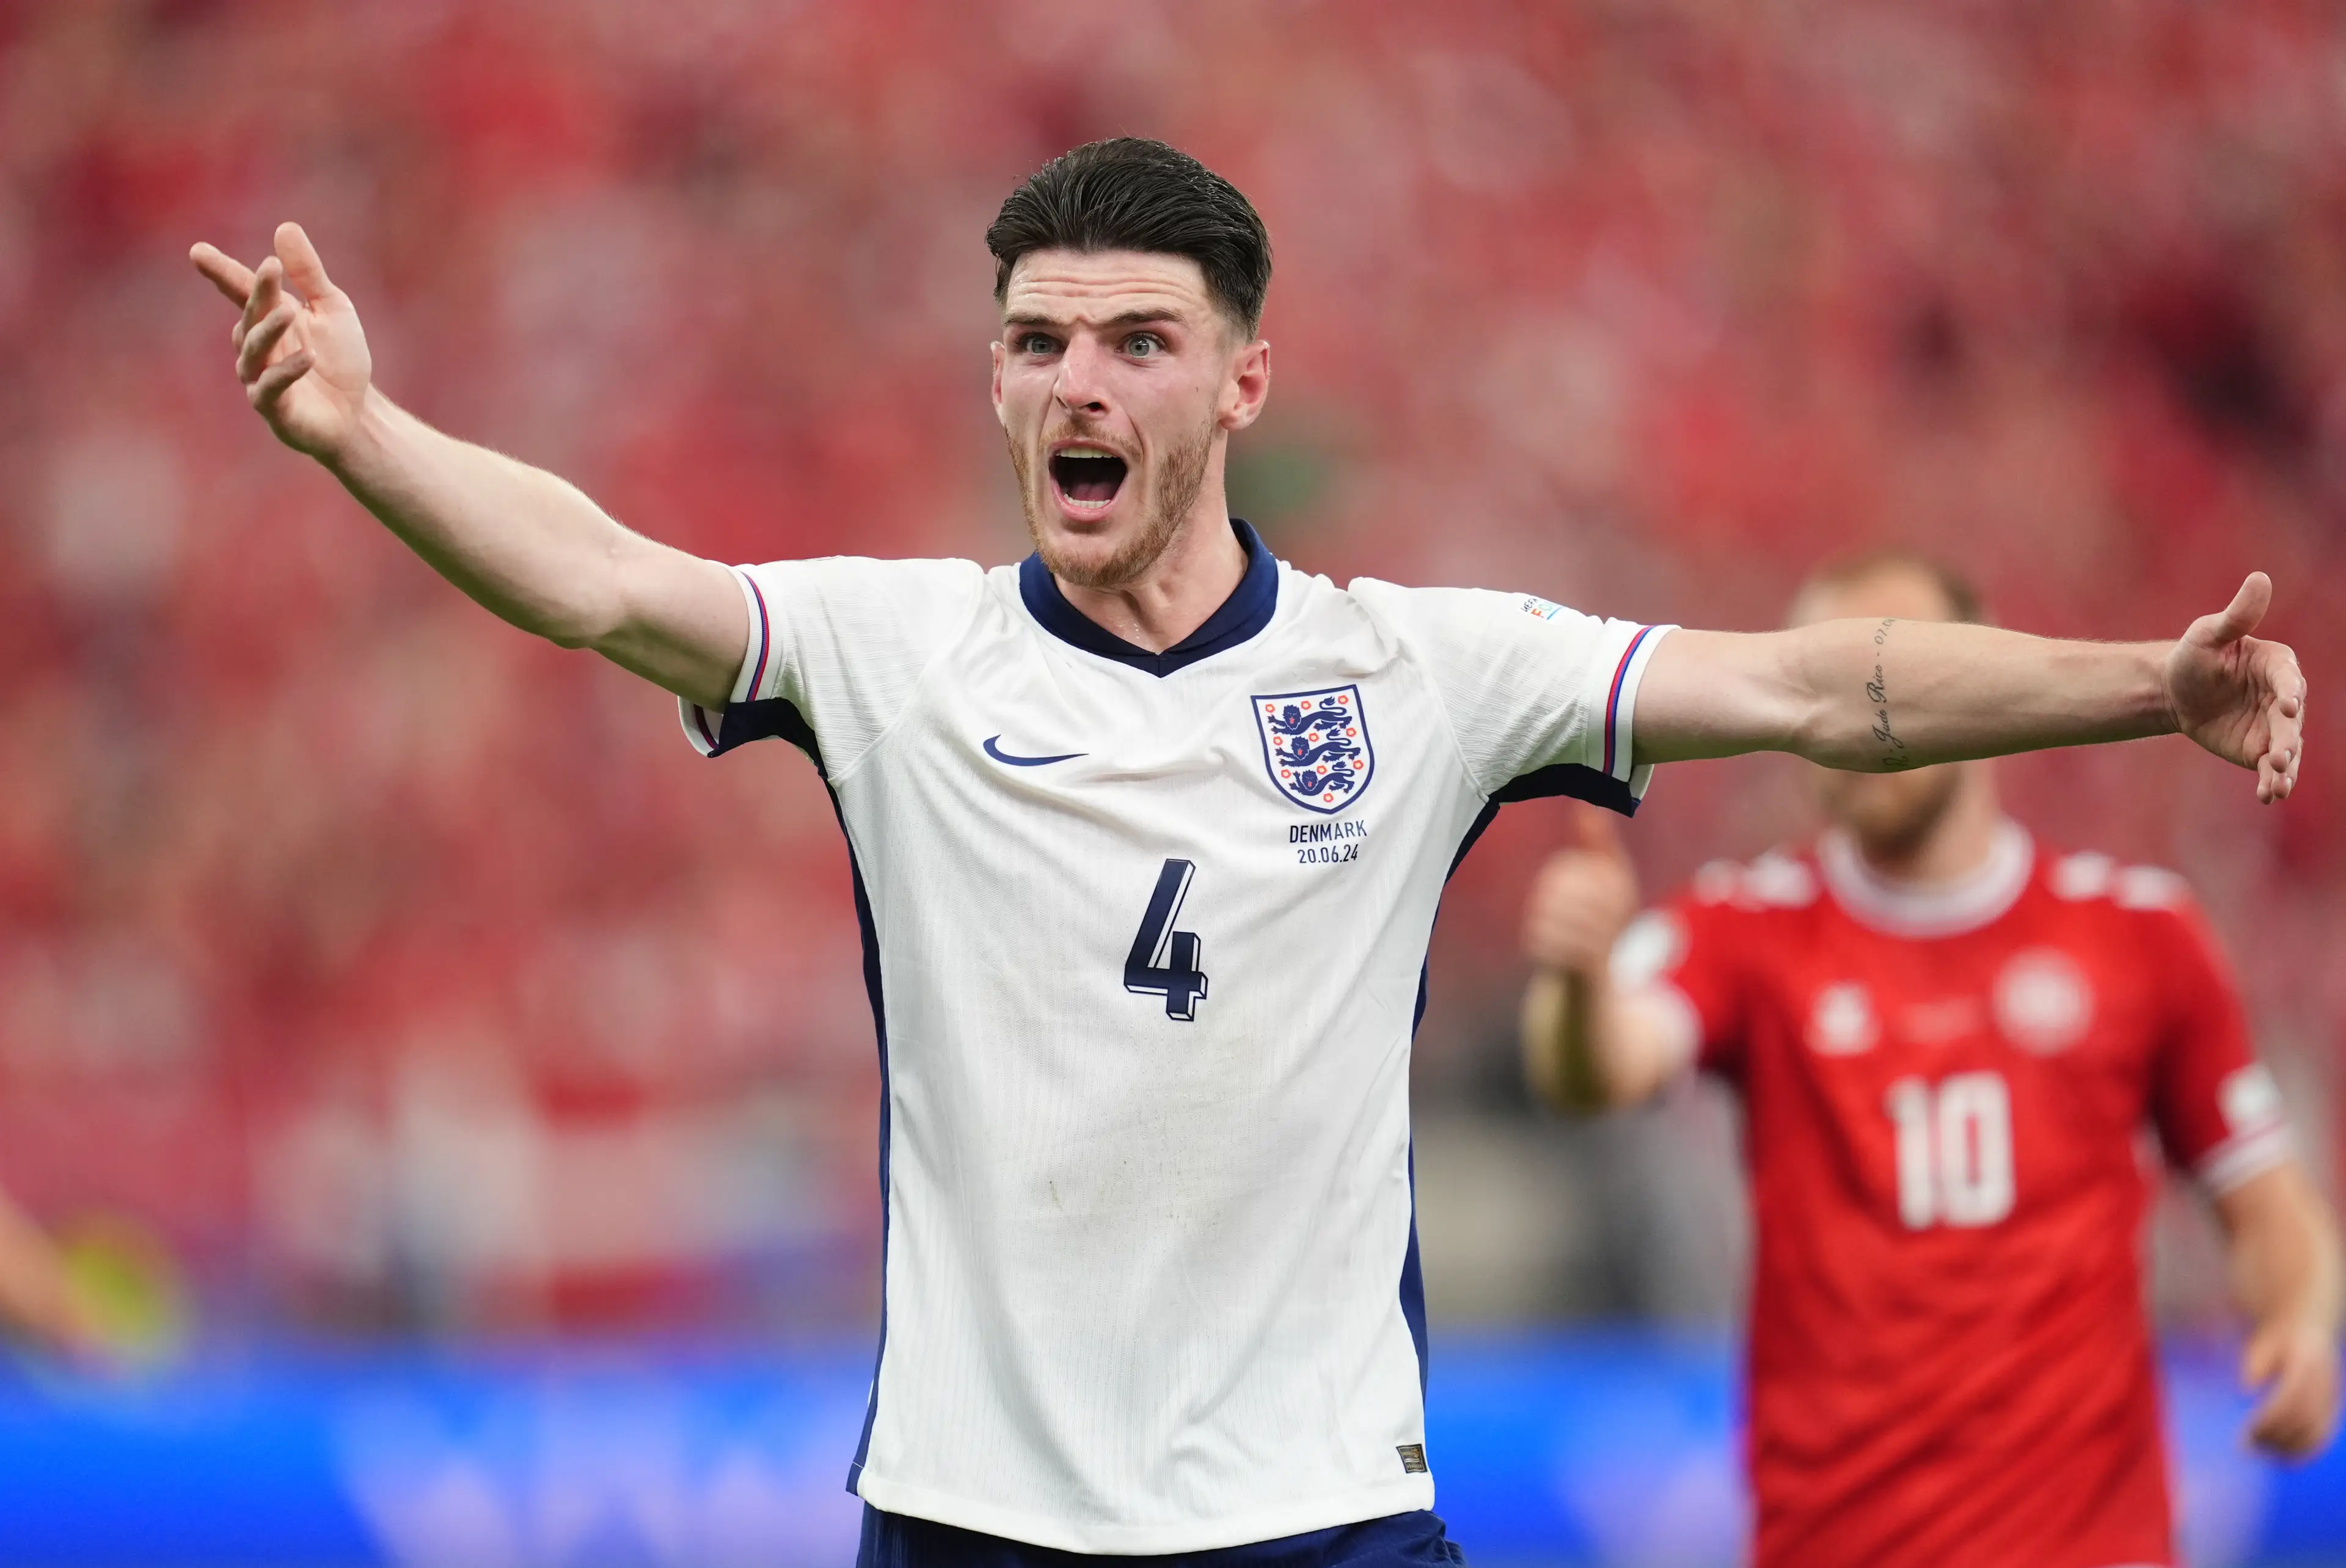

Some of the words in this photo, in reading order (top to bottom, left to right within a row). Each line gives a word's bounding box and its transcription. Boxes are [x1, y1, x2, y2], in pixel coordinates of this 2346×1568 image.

[1521, 598, 1539, 612] UEFA
[1866, 664, 1887, 703] Rice
[1872, 709, 1905, 748] Jude
[1290, 820, 1367, 843] DENMARK
[1297, 844, 1359, 864] 20.06.24
[1124, 858, 1208, 1021] 4
[1888, 1071, 2014, 1230] 10
